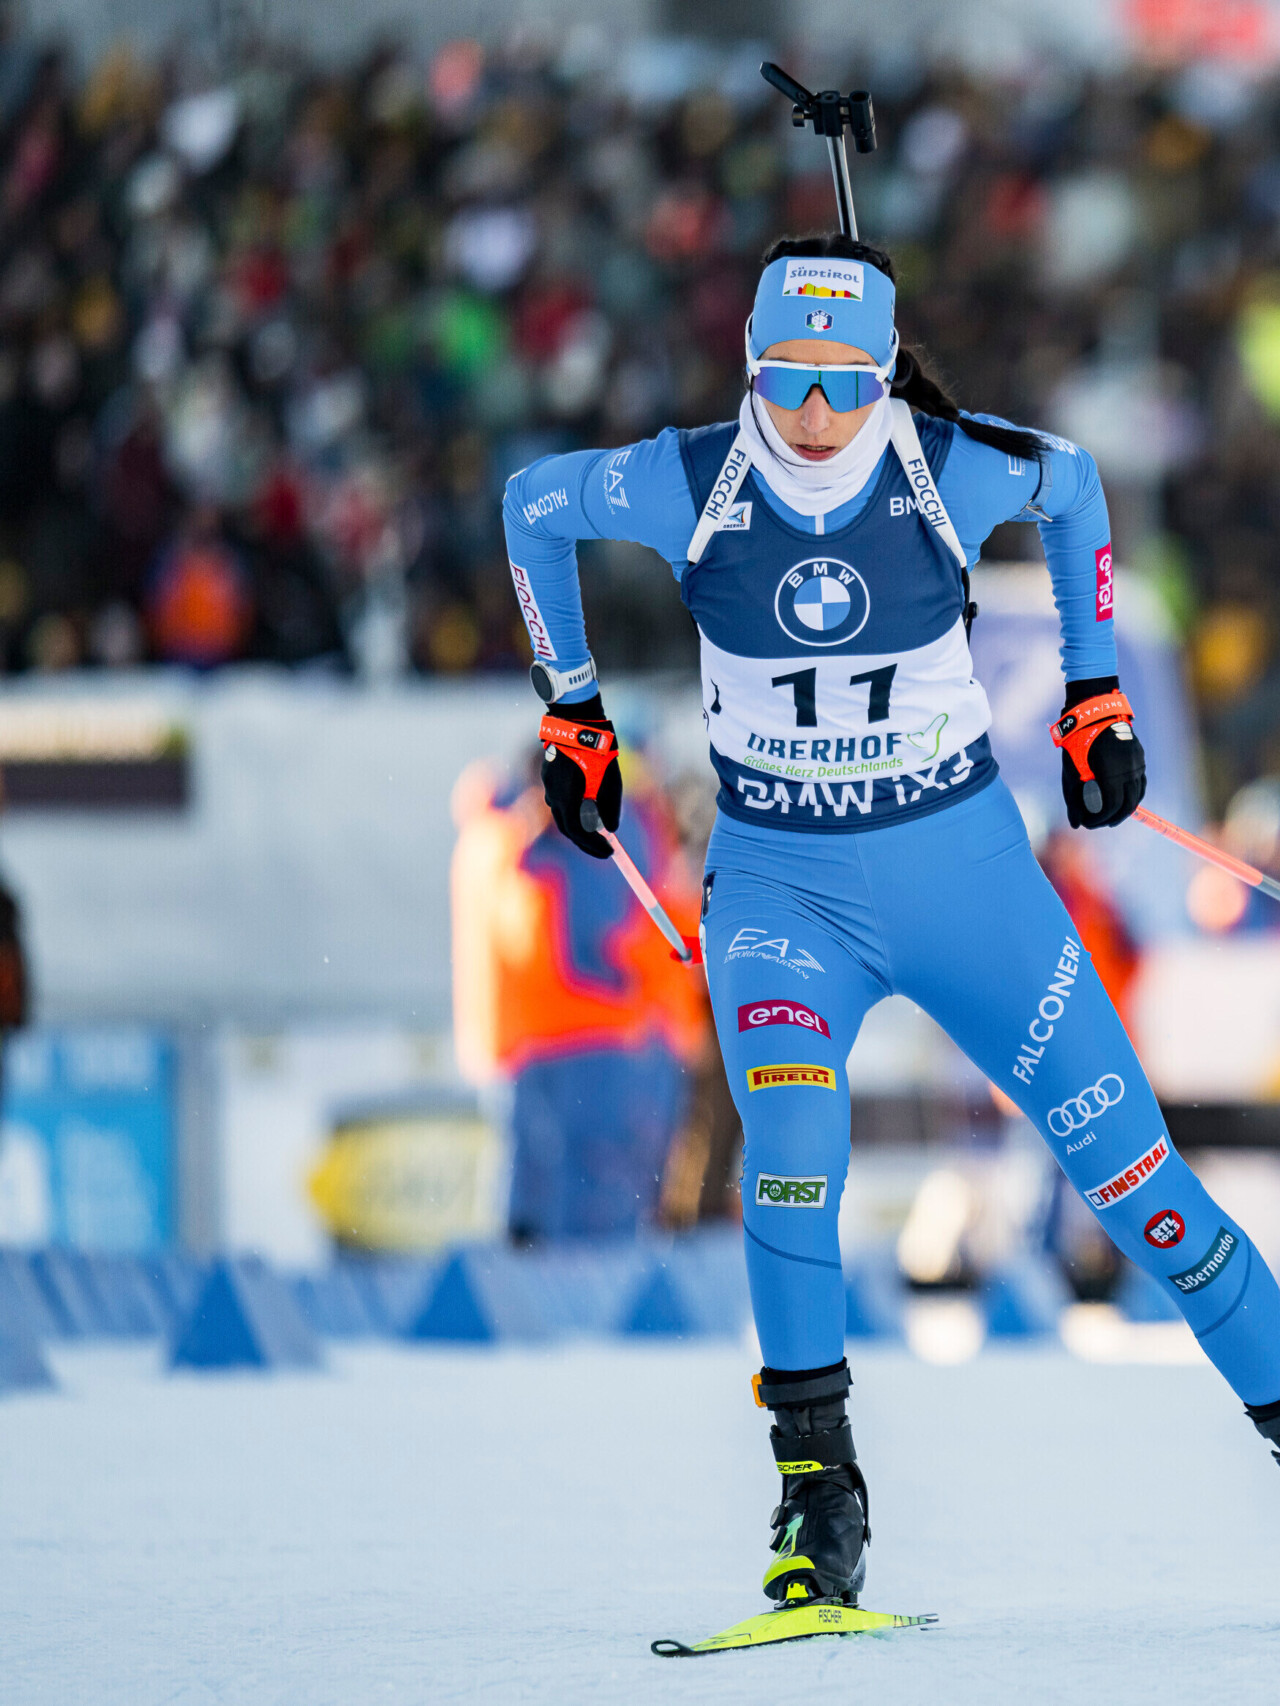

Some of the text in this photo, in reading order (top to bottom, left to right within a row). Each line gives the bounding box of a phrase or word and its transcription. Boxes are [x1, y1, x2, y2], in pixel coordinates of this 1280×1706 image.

[705, 448, 746, 520] FIOCCHI
[908, 457, 947, 528] FIOCCHI
[788, 562, 856, 589] BMW
[1099, 553, 1112, 613] enel
[510, 563, 552, 658] FIOCCHI
[771, 663, 898, 728] 11
[744, 755, 903, 778] Grünes Herz Deutschlands
[723, 951, 761, 964] EMPORIO
[748, 1006, 822, 1032] enel
[1012, 936, 1080, 1085] FALCONERI
[753, 1067, 829, 1086] PIRELLI
[1066, 1131, 1097, 1155] Audi
[1098, 1142, 1168, 1203] FINSTRAL
[758, 1179, 825, 1204] FORST
[1149, 1216, 1176, 1240] RTL
[1157, 1222, 1181, 1244] 102.5
